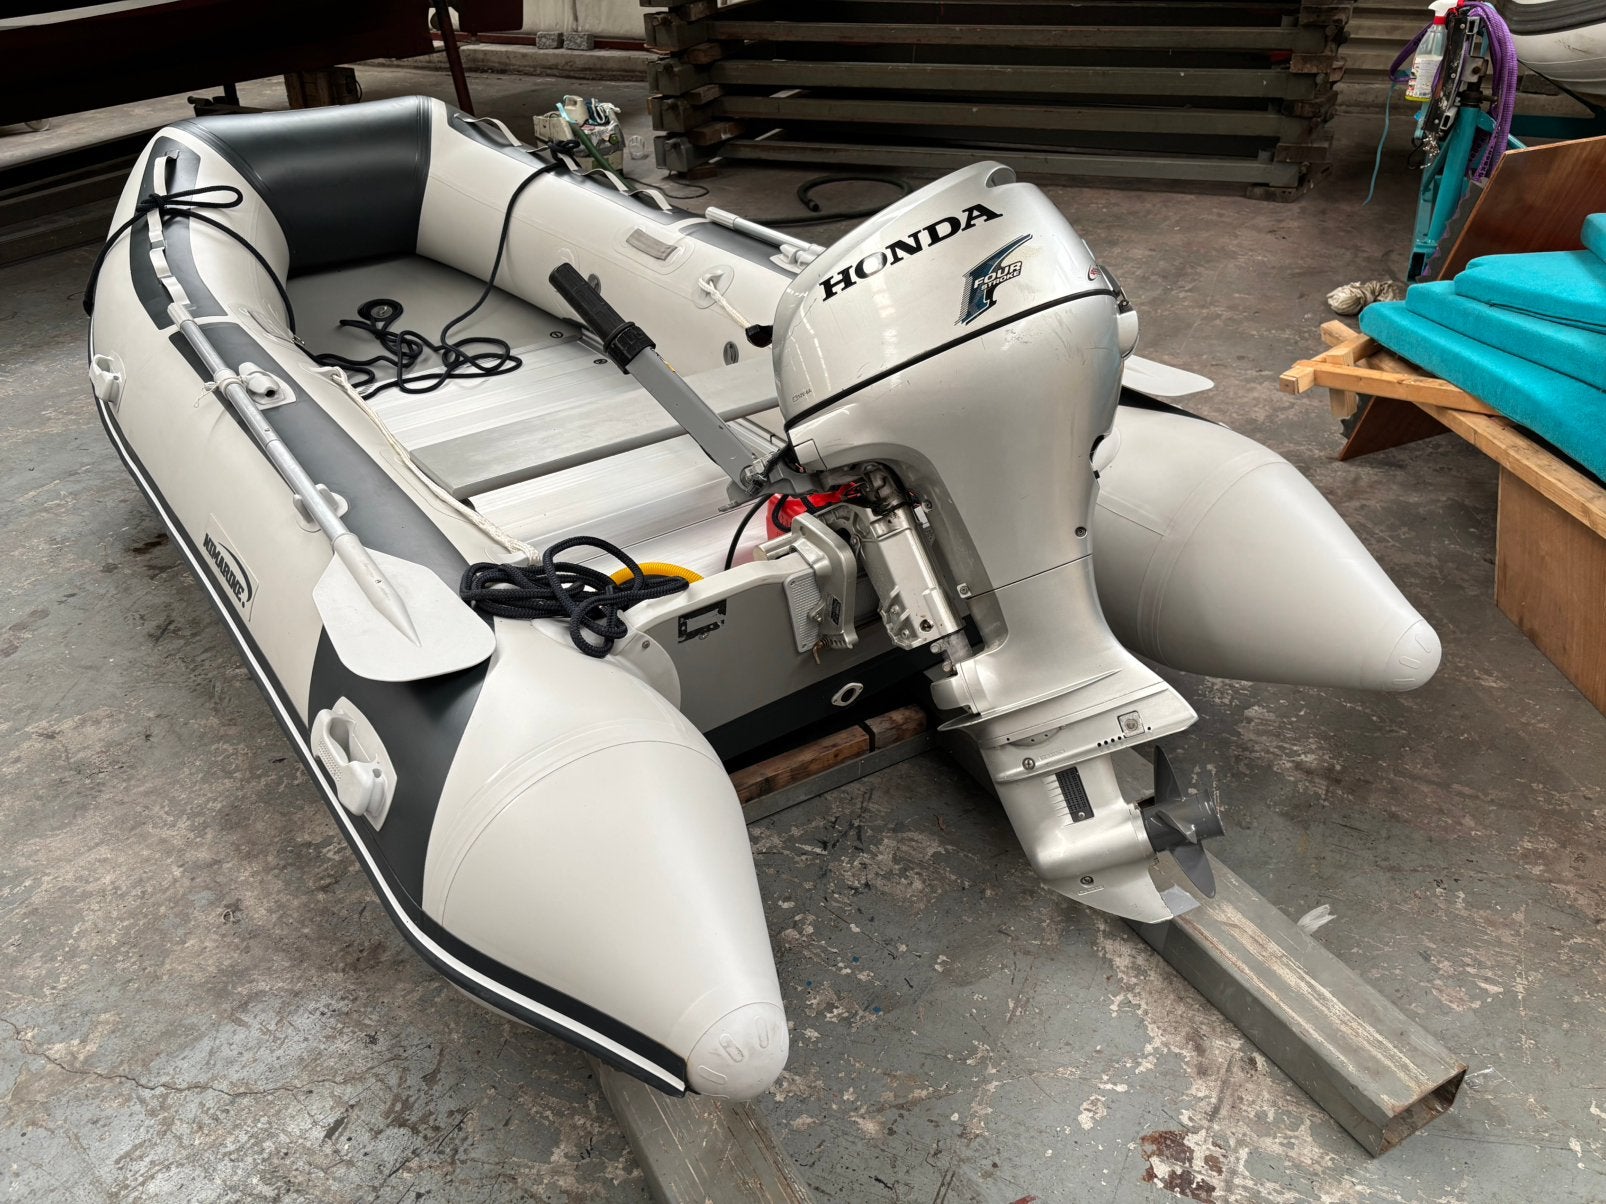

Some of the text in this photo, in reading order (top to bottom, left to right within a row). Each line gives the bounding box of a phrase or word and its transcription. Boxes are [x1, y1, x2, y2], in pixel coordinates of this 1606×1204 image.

[819, 203, 1003, 301] HONDA
[973, 261, 1021, 289] FOUR
[980, 270, 1020, 291] STROKE
